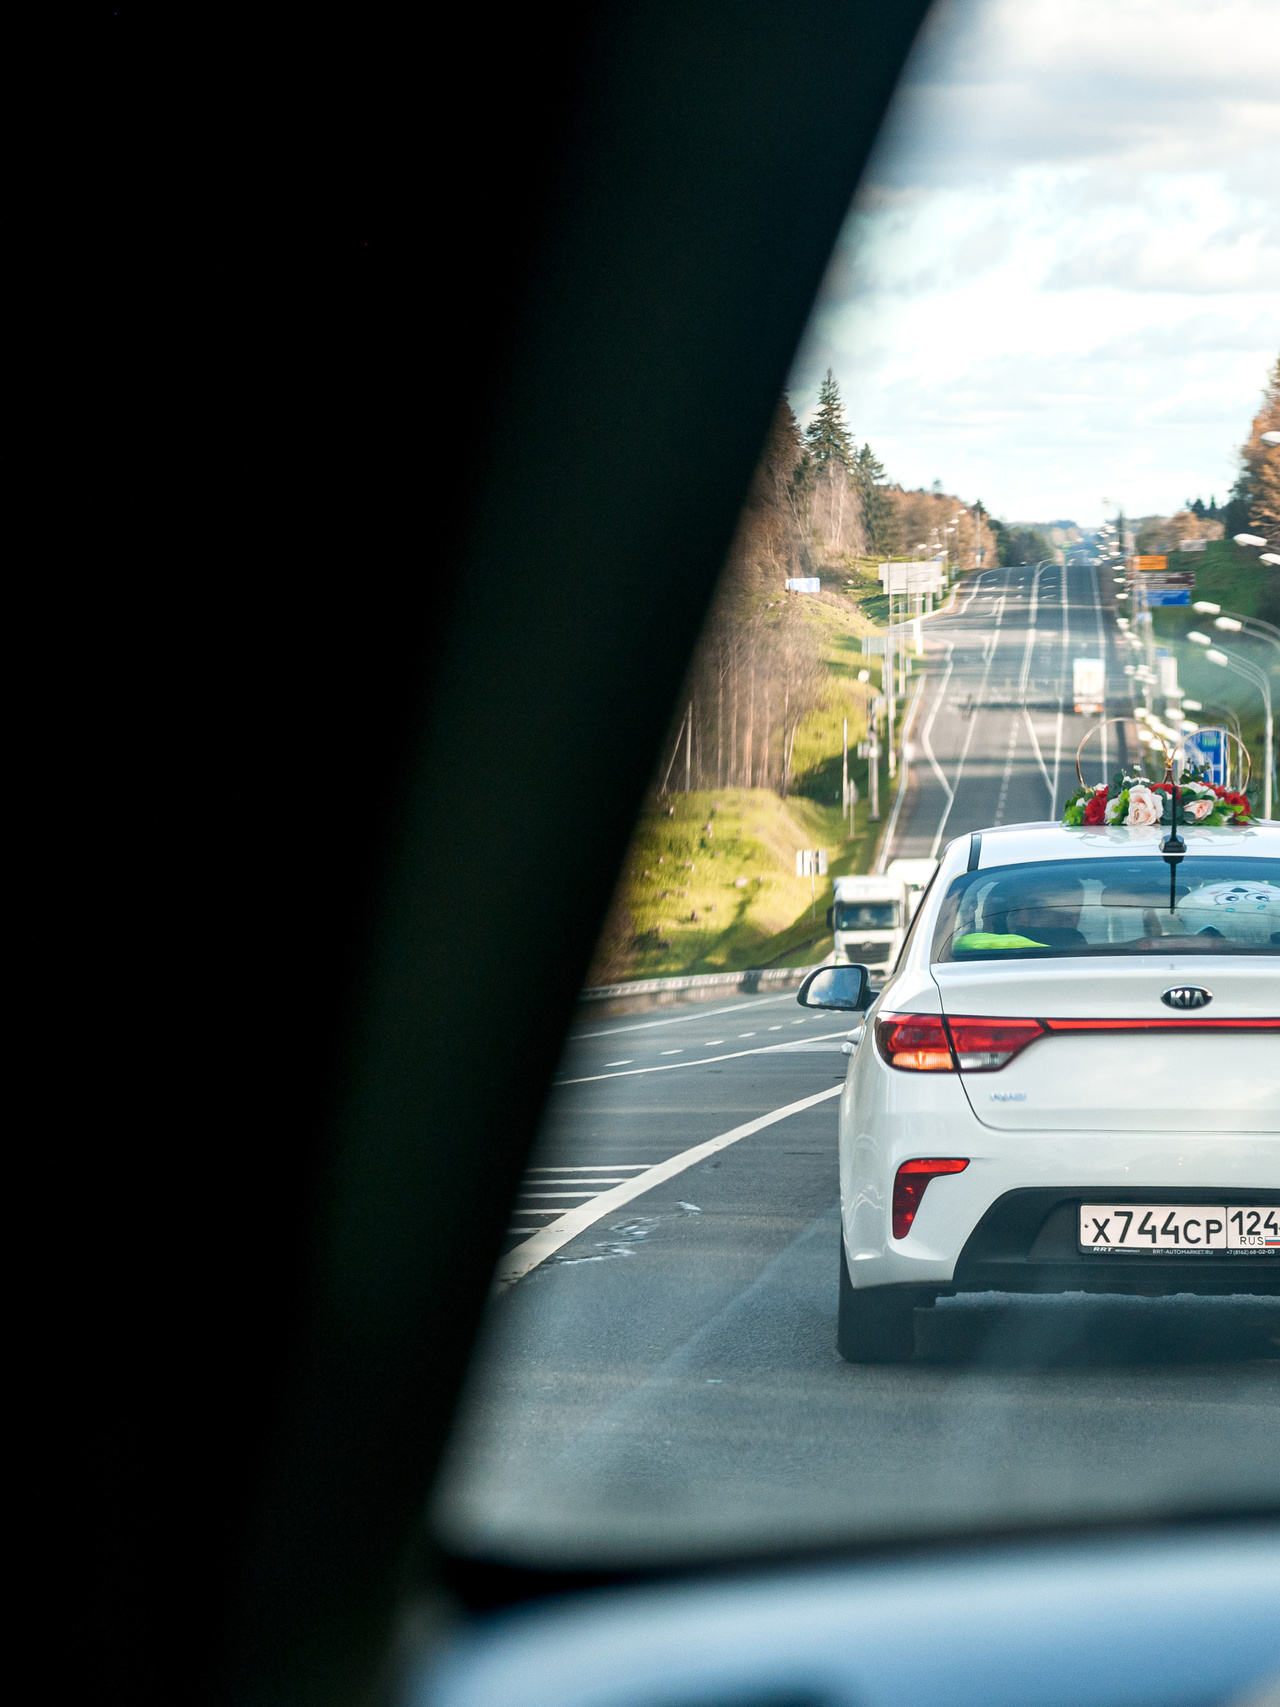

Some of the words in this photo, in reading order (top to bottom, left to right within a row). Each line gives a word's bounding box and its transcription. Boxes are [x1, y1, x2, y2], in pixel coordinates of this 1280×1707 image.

[1170, 990, 1205, 1006] KIA
[1230, 1210, 1279, 1236] 124
[1239, 1236, 1264, 1246] RUS
